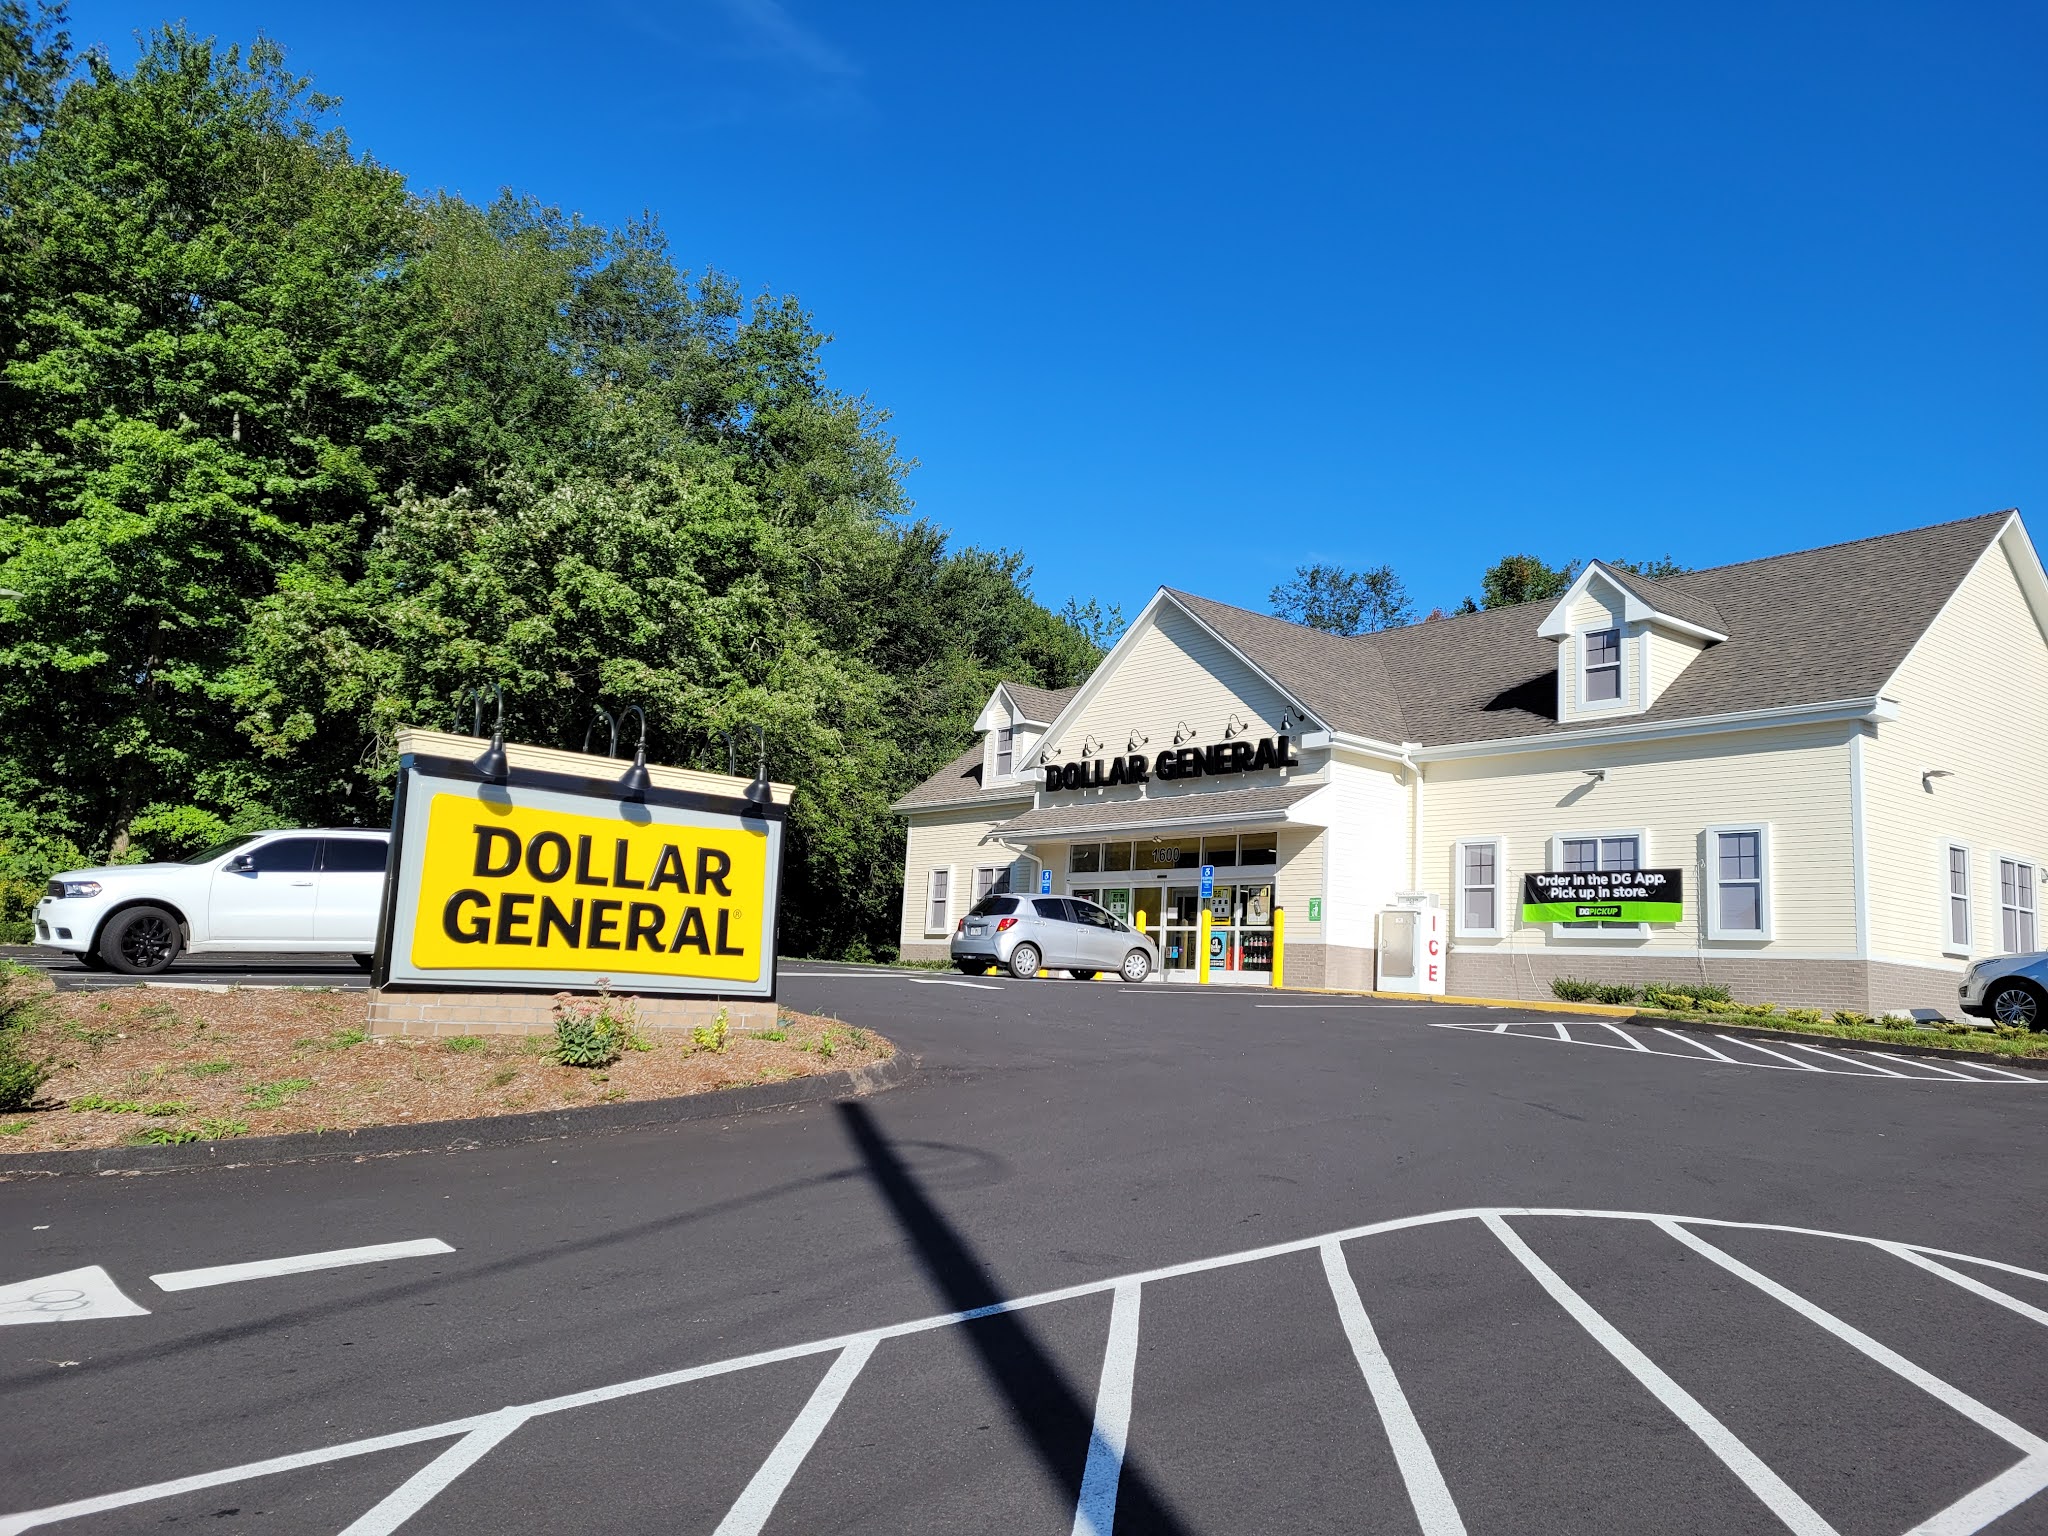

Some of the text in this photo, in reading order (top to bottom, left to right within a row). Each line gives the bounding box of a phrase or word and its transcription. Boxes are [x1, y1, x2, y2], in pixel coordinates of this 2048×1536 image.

[1045, 736, 1298, 792] DOLLAR GENERAL
[473, 824, 732, 897] DOLLAR
[1152, 847, 1180, 863] 1600
[1536, 873, 1667, 888] Order in the DG App.
[1551, 886, 1649, 900] Pick up in store.
[442, 888, 745, 956] GENERAL
[1428, 915, 1439, 982] ICE
